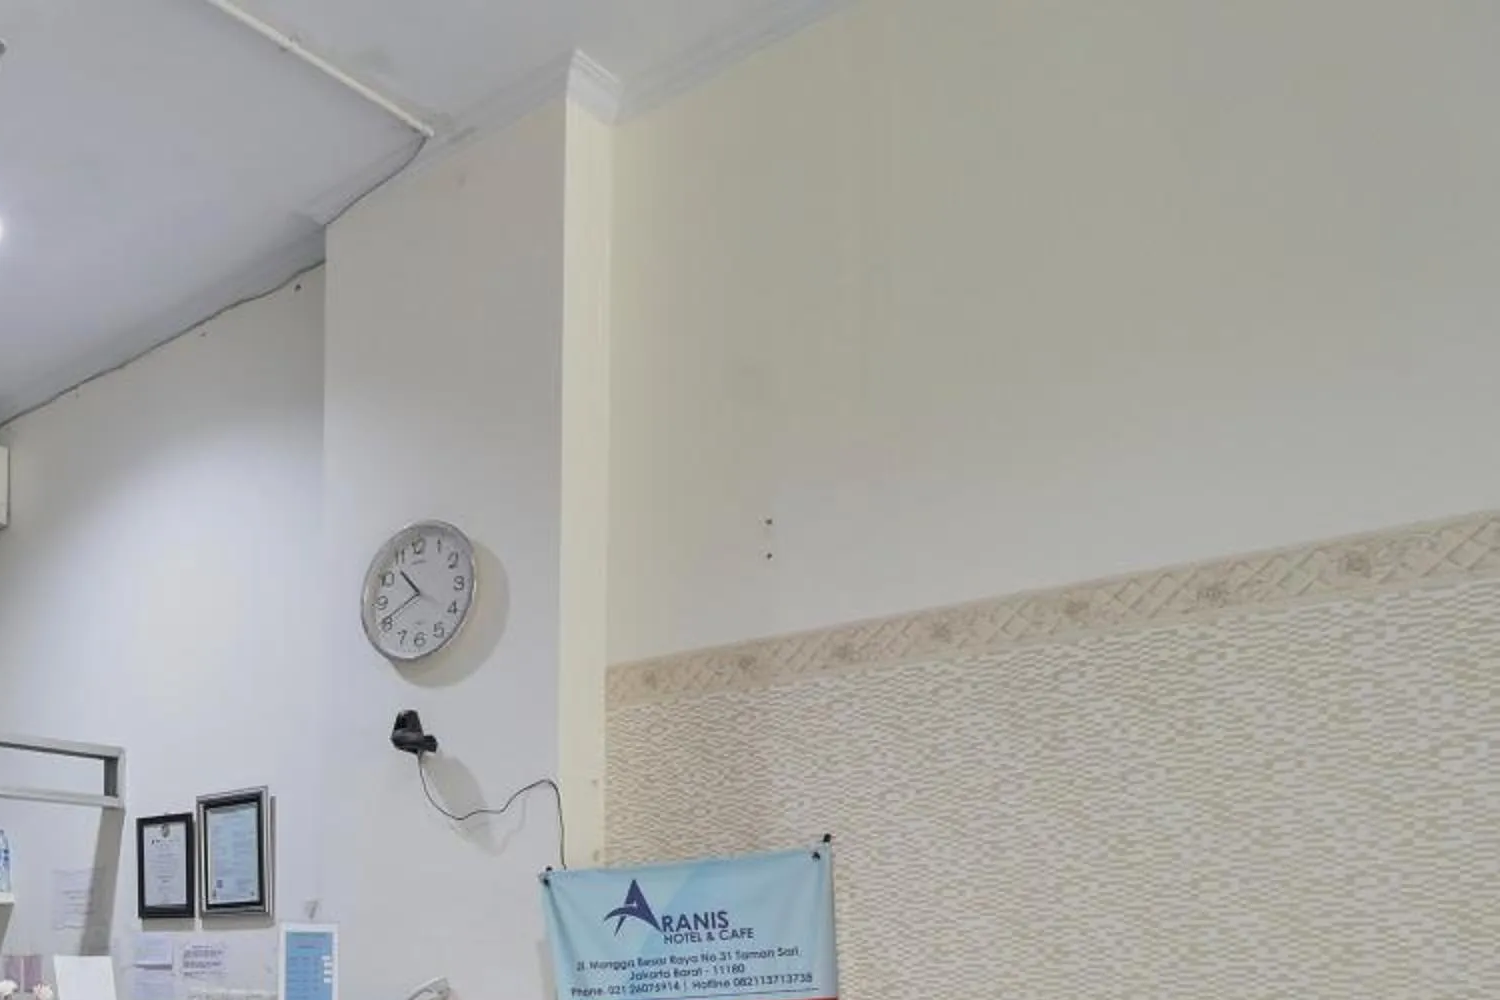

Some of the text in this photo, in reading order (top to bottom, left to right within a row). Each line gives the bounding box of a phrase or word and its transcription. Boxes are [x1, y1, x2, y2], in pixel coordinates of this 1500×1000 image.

[436, 539, 442, 553] 1
[394, 549, 406, 565] 11
[447, 552, 459, 569] 2
[380, 571, 395, 587] 10
[453, 575, 465, 591] 3
[373, 596, 389, 610] 9
[447, 601, 458, 614] 4
[381, 616, 394, 632] 8
[433, 623, 445, 638] 5
[397, 630, 408, 645] 7
[413, 632, 426, 647] 6
[663, 927, 755, 944] HOTEL & CAFE
[669, 954, 699, 966] Raya
[629, 968, 671, 981] Jakarta
[673, 966, 702, 978] Barat
[713, 962, 745, 975] 11180
[692, 977, 730, 990] Hotline
